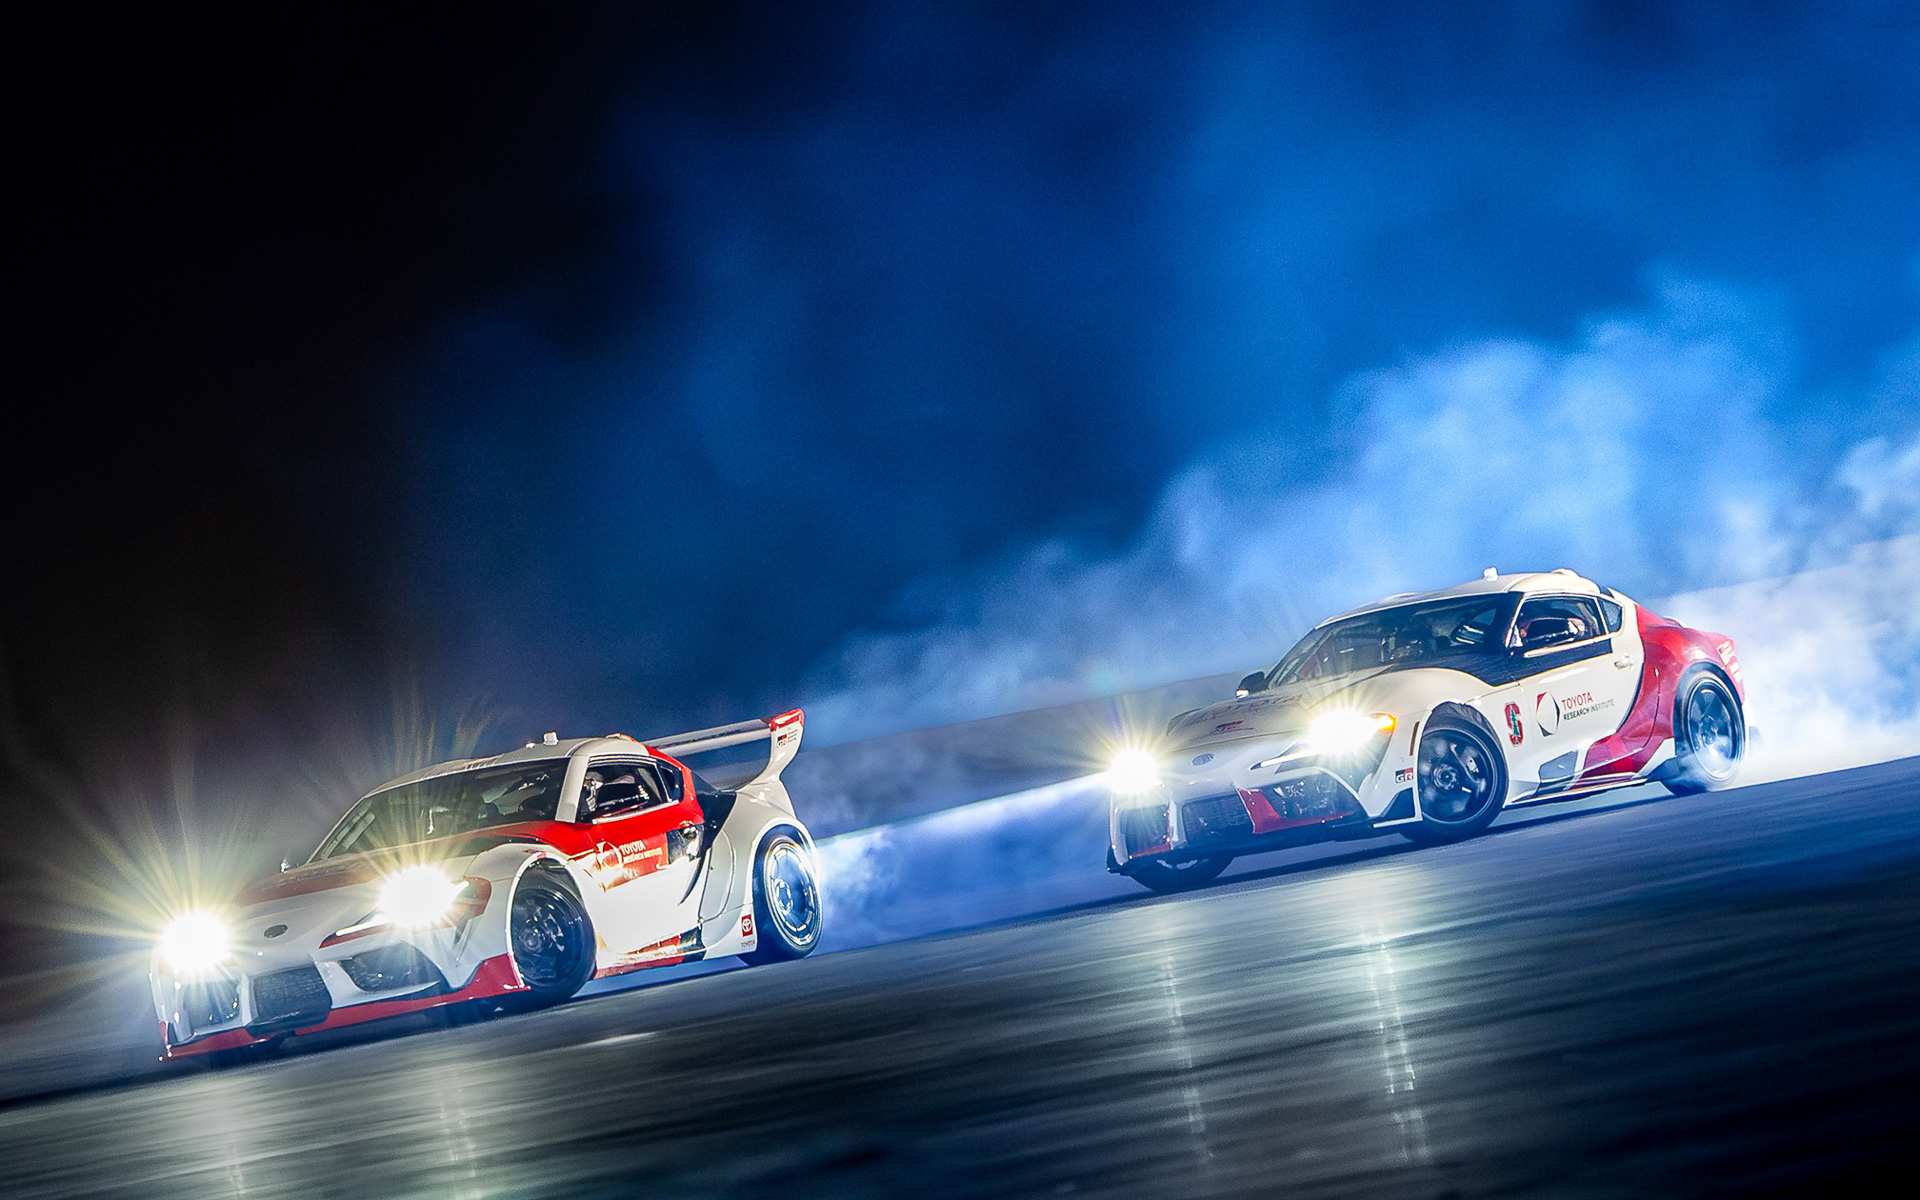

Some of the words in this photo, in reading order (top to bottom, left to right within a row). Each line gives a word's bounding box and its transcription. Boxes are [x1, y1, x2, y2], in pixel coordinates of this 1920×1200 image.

[1561, 692, 1593, 711] TOYOTA
[1563, 707, 1590, 720] RESEARCH
[1395, 771, 1414, 783] GR
[618, 839, 647, 856] TOYOTA
